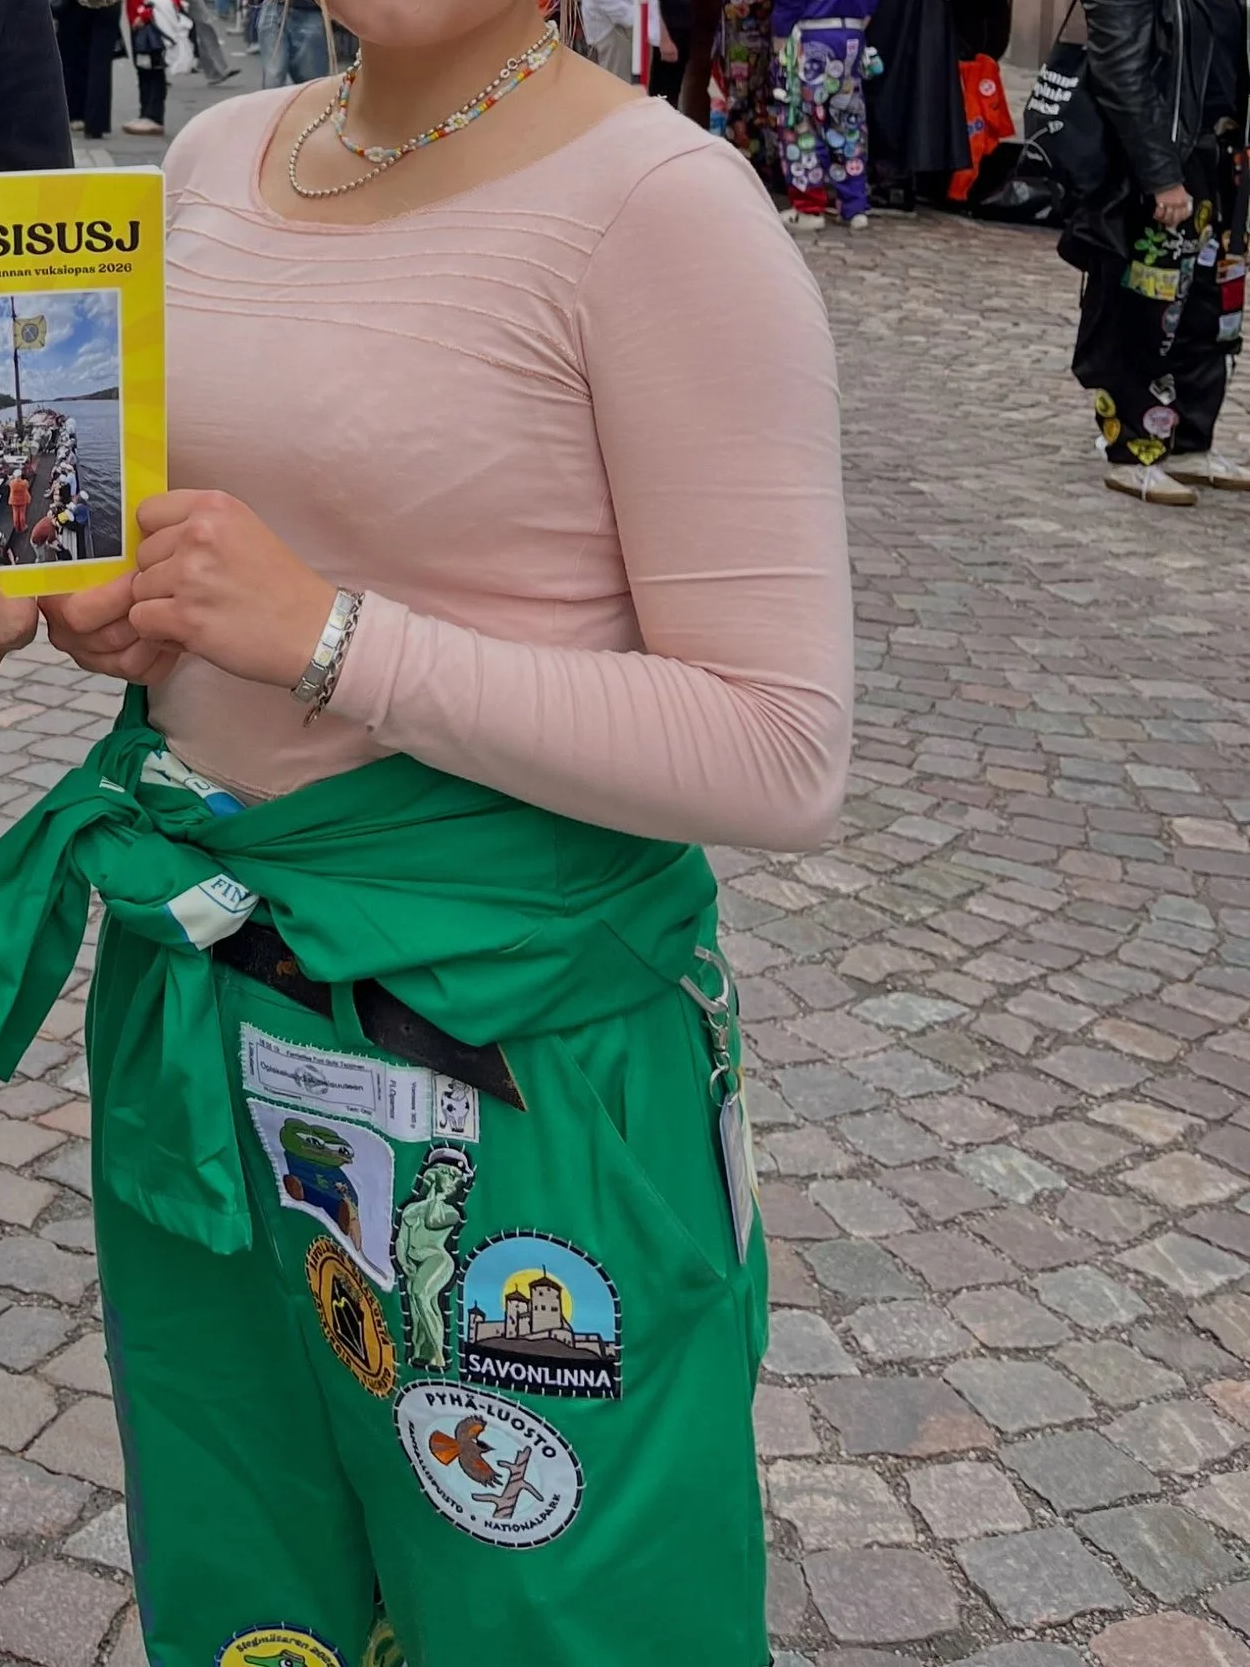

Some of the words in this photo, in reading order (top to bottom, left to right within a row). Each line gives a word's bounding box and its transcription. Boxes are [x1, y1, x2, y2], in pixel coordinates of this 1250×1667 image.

[34, 264, 96, 277] vuksiopas
[98, 262, 133, 274] 2026
[469, 1353, 612, 1388] SAVONLINNA
[425, 1392, 558, 1459] PYHÄ-LUOSTO
[407, 1419, 464, 1515] KANSALLISPUISTO
[483, 1492, 562, 1534] NATIONALPARK
